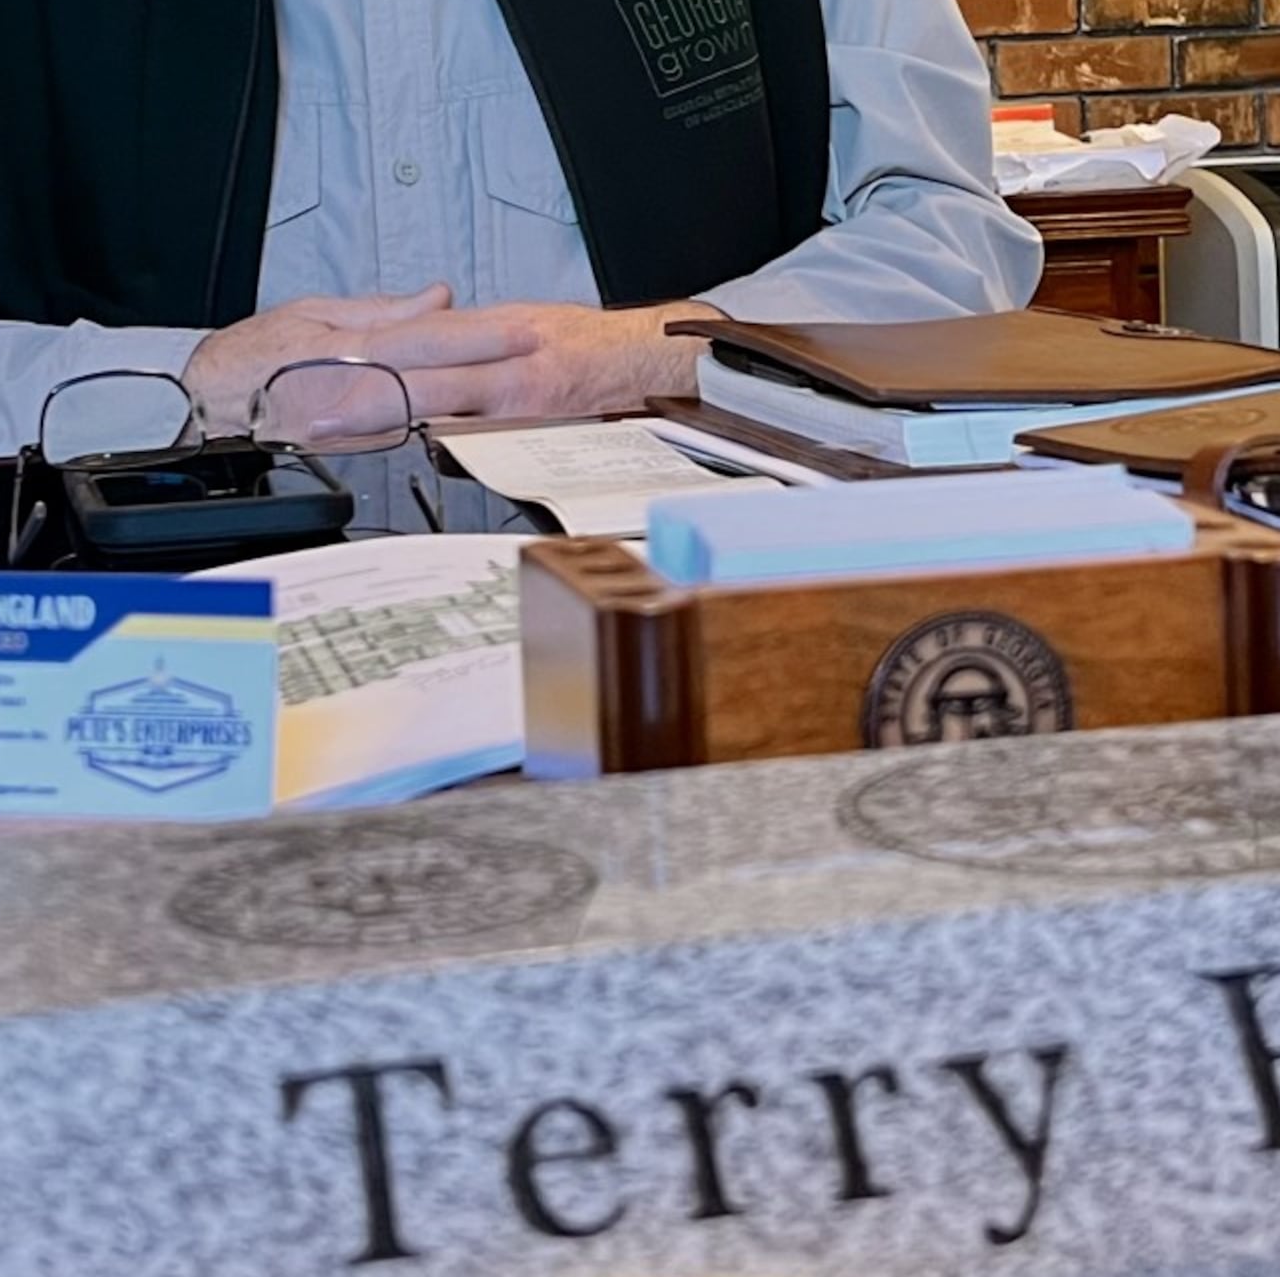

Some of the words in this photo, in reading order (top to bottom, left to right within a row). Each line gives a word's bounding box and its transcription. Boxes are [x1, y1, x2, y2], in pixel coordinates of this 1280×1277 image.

[657, 21, 755, 82] grown
[133, 718, 252, 746] ENTERPRISES
[278, 1041, 1072, 1266] Terry
